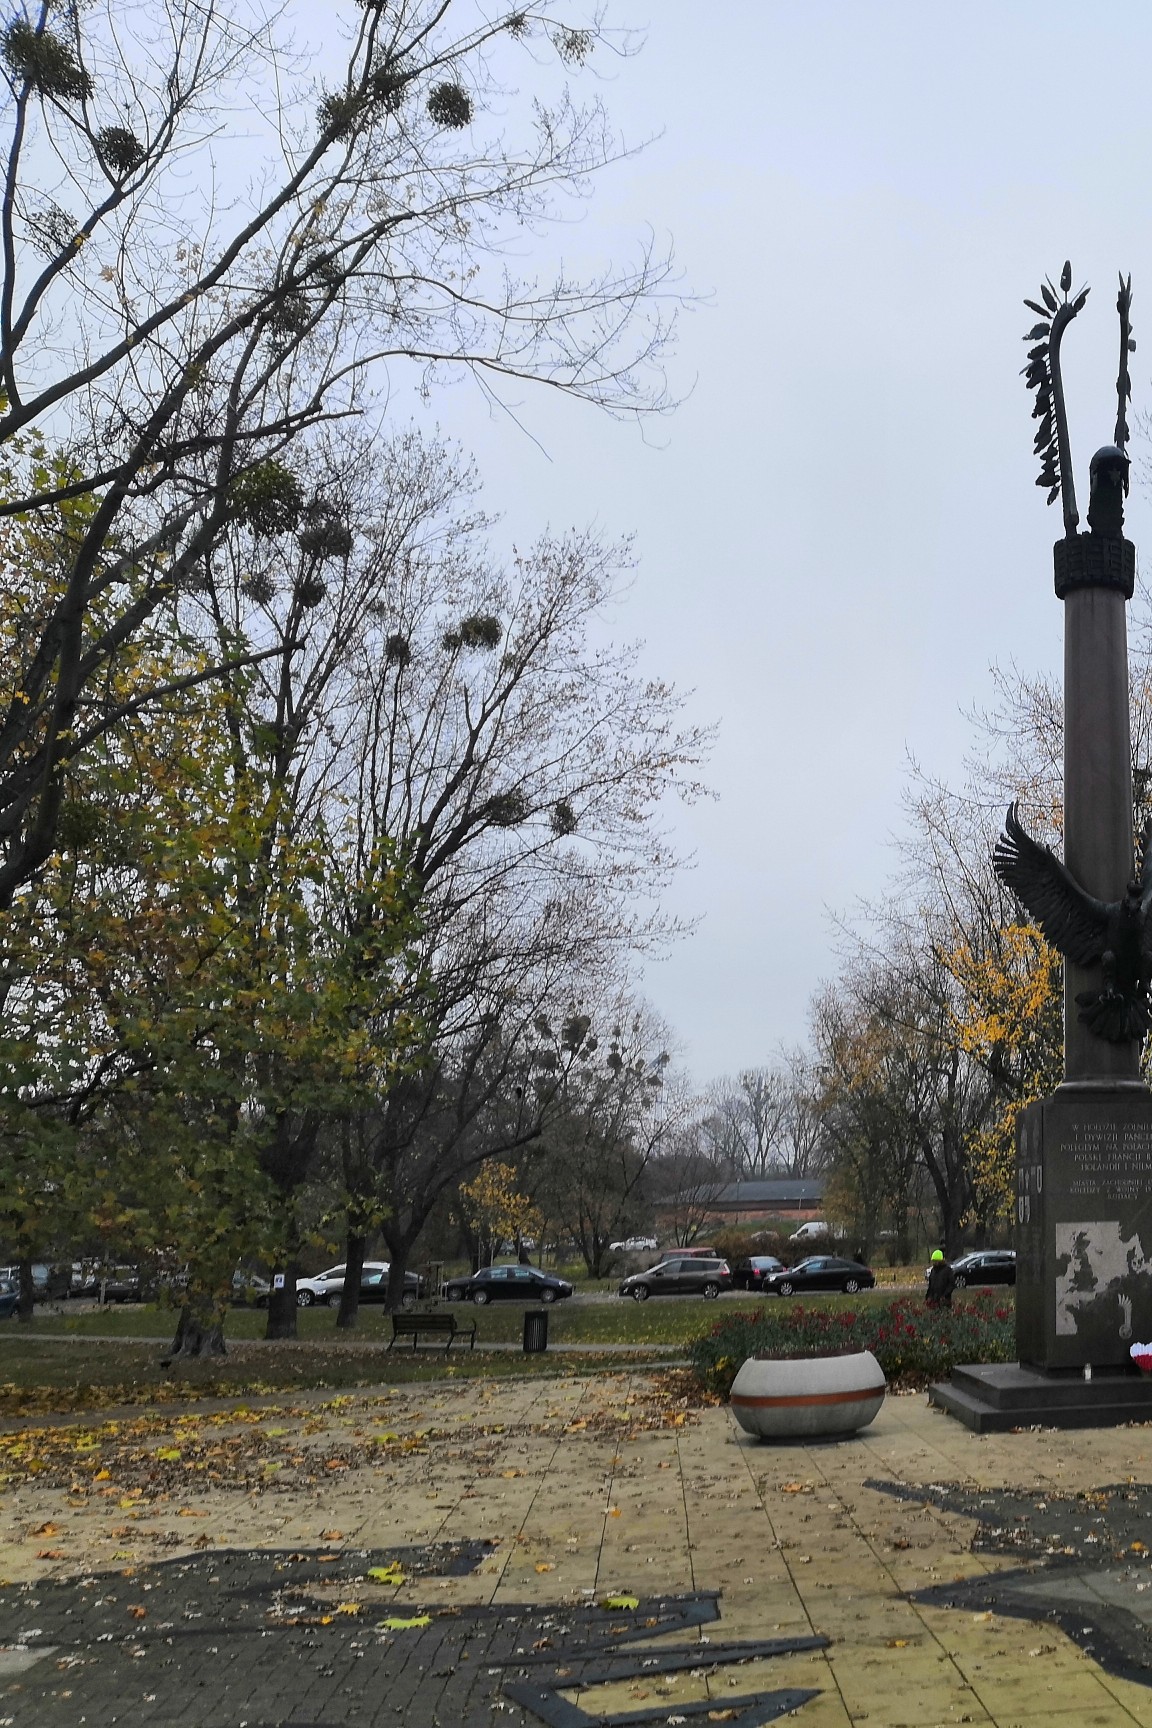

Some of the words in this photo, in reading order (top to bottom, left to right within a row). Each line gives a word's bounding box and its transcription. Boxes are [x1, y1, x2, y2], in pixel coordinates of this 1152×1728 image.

[1084, 1133, 1118, 1141] DYWIZJI
[1106, 1143, 1118, 1151] NA
[1107, 1153, 1141, 1161] FRANCJI
[1081, 1163, 1120, 1171] HOLANDII
